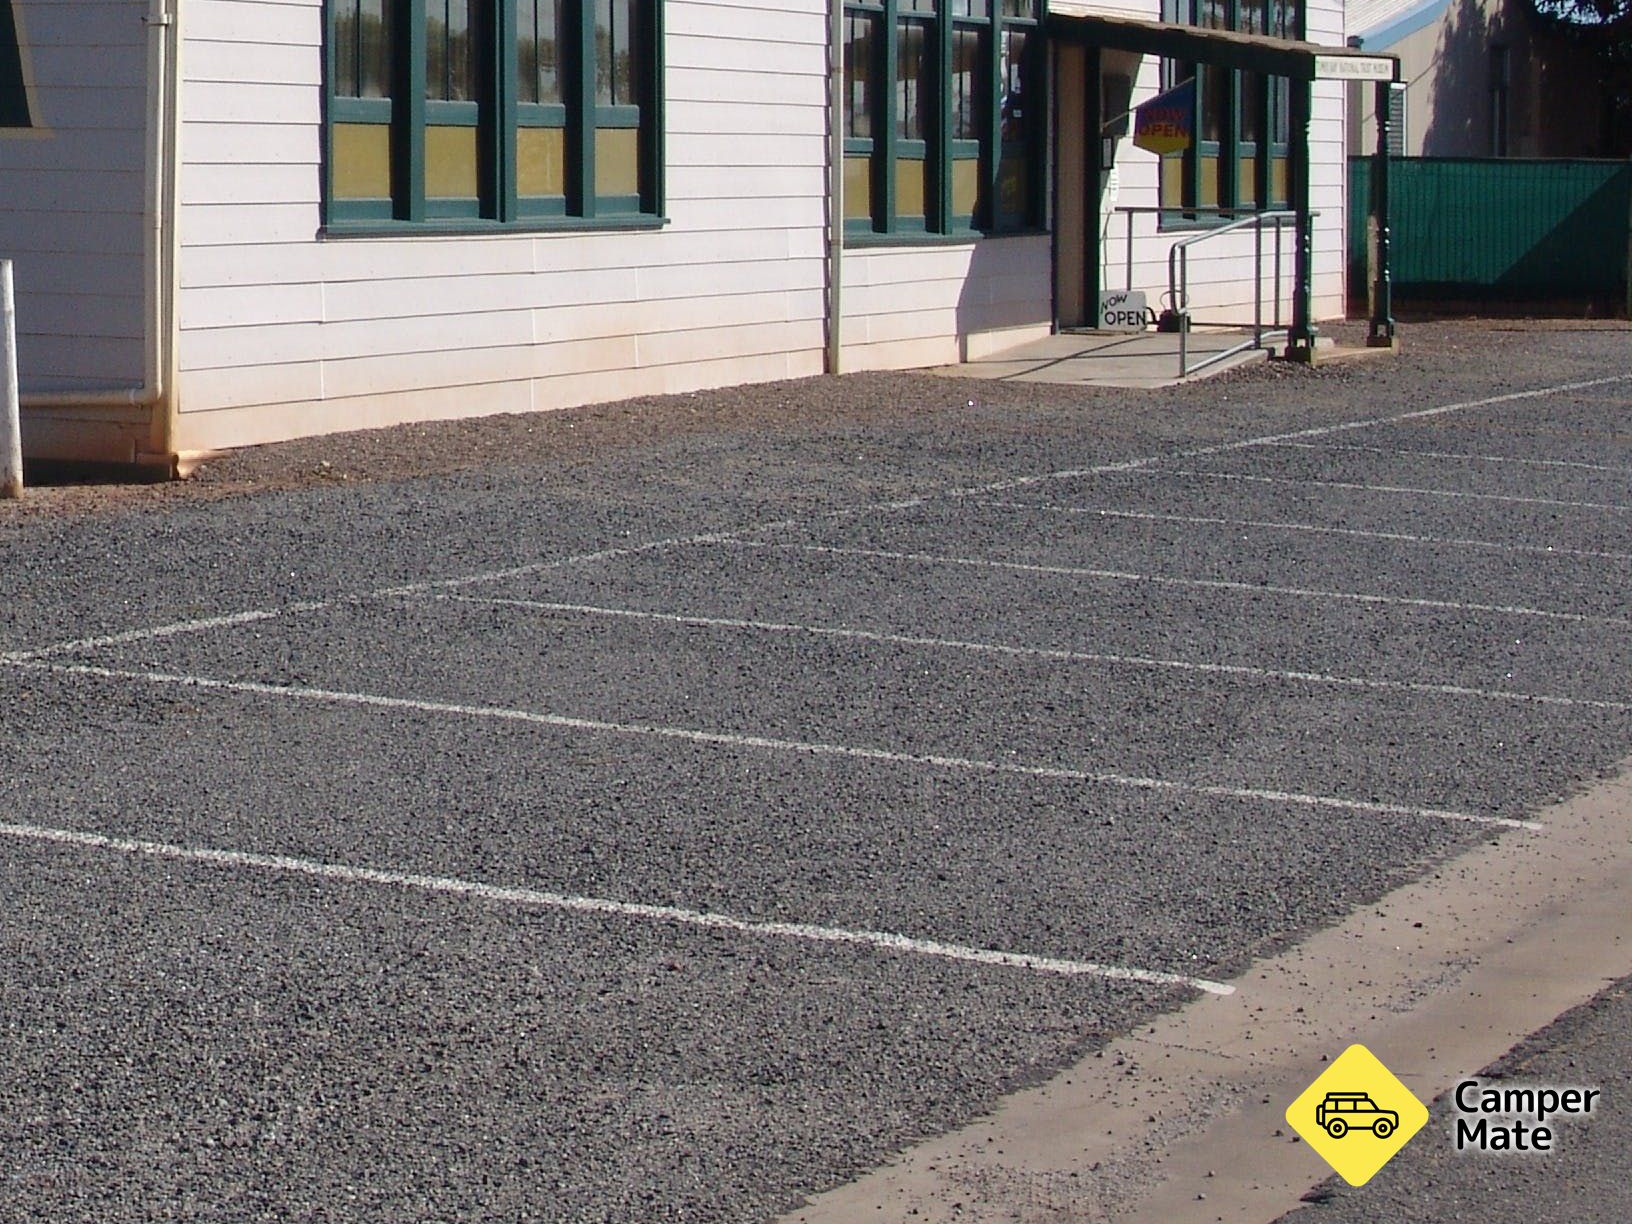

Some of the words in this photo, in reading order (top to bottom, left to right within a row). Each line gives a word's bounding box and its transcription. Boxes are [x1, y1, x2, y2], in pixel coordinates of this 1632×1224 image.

[1138, 122, 1188, 138] OPEN
[1100, 294, 1128, 314] NOW
[1104, 311, 1146, 326] OPEN
